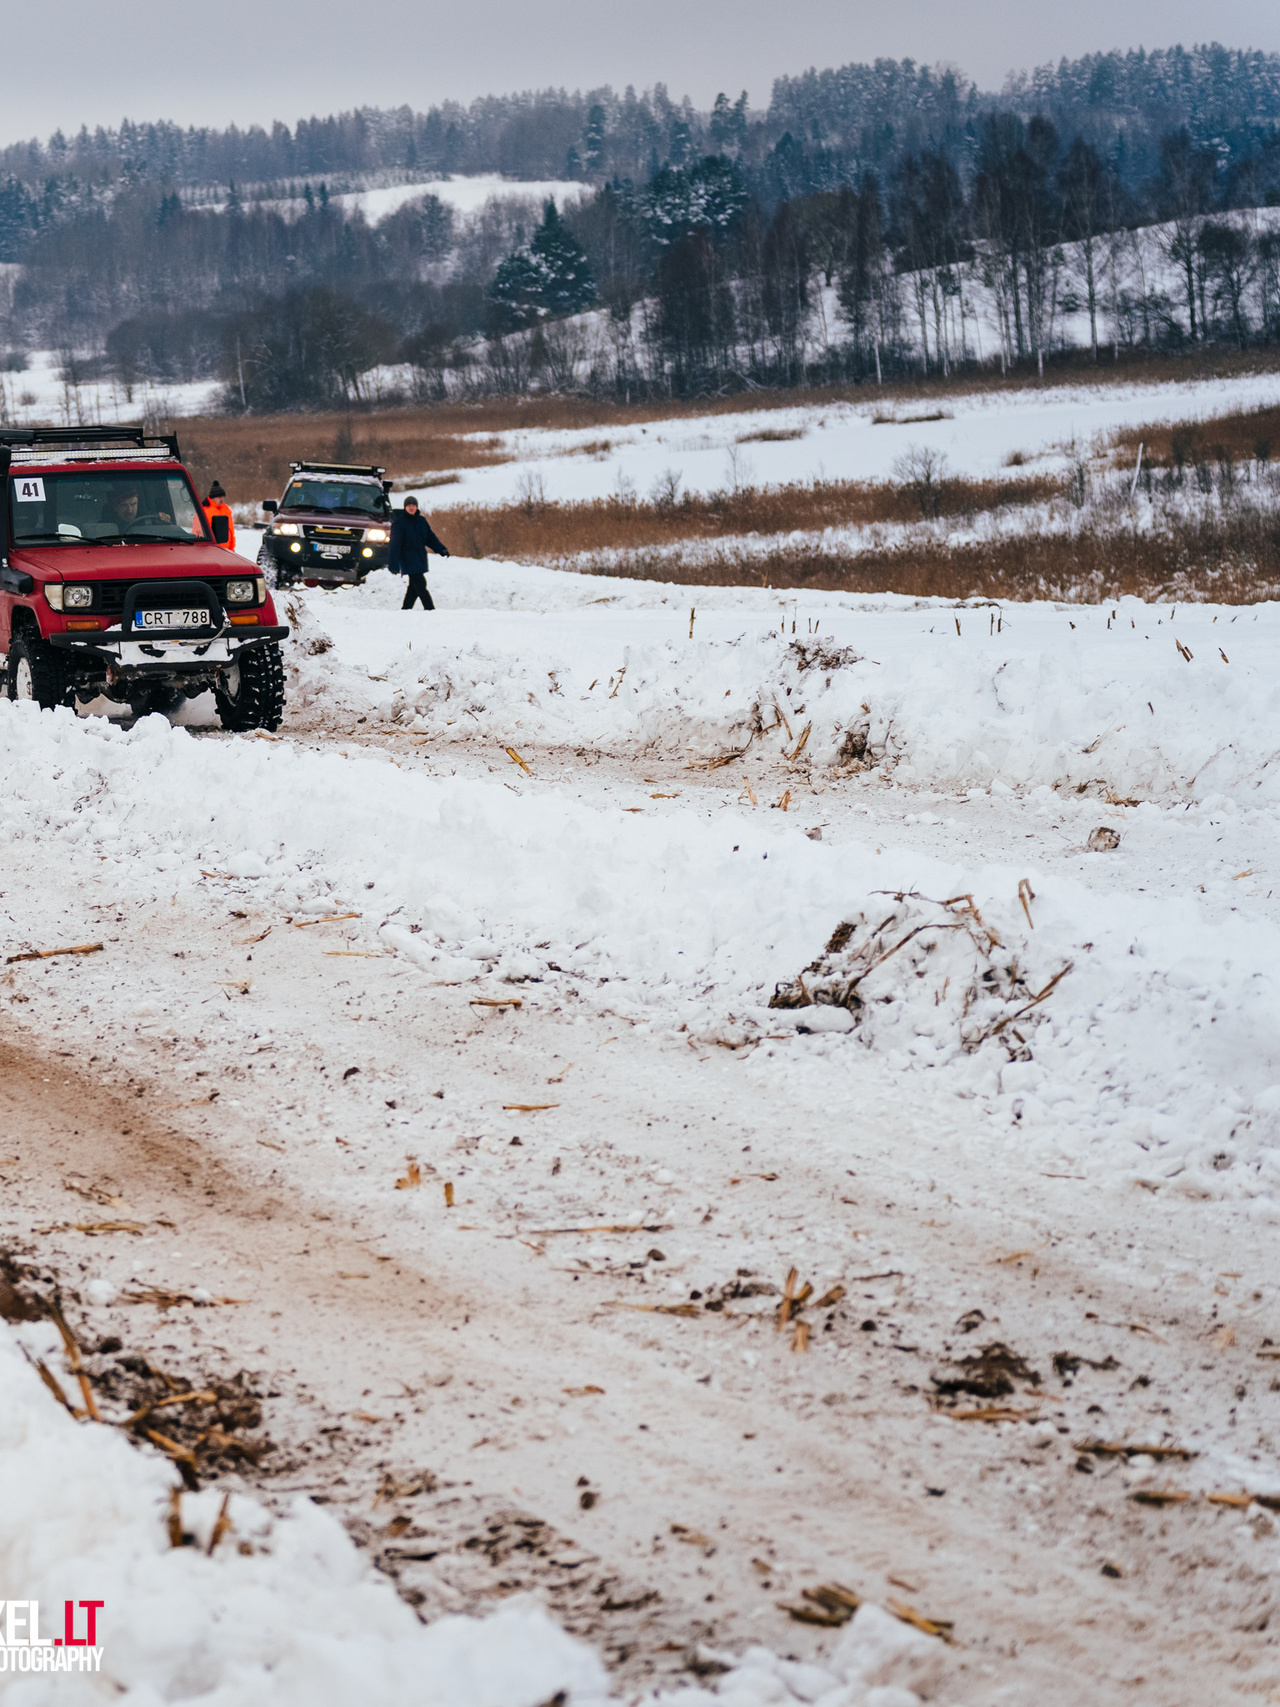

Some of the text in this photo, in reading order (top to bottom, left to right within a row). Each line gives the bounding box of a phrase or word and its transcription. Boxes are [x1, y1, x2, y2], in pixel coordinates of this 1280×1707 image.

[22, 482, 39, 497] 41
[144, 611, 208, 625] CRT 788
